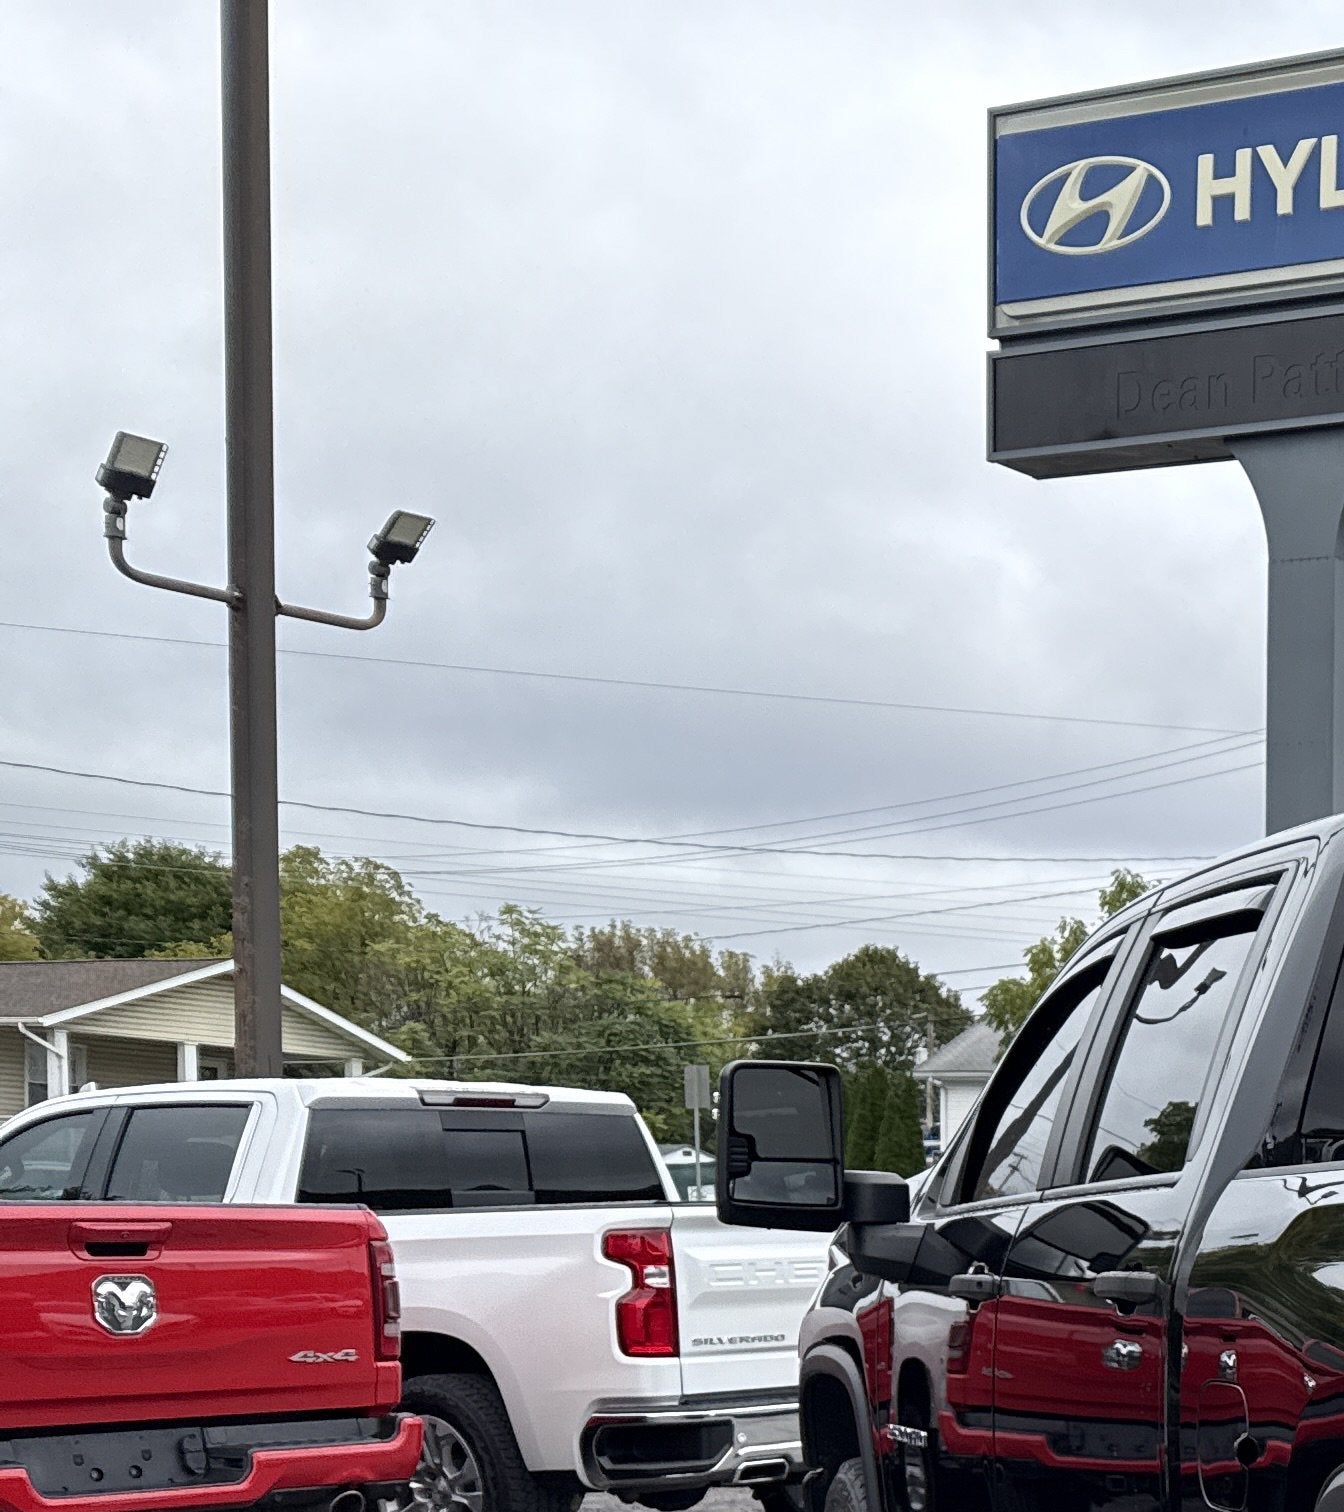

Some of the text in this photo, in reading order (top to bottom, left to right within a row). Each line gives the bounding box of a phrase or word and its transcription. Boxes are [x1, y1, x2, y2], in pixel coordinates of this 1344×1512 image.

[1115, 370, 1229, 419] Dean
[691, 1333, 786, 1347] SILVERADO
[287, 1348, 360, 1364] 4x4
